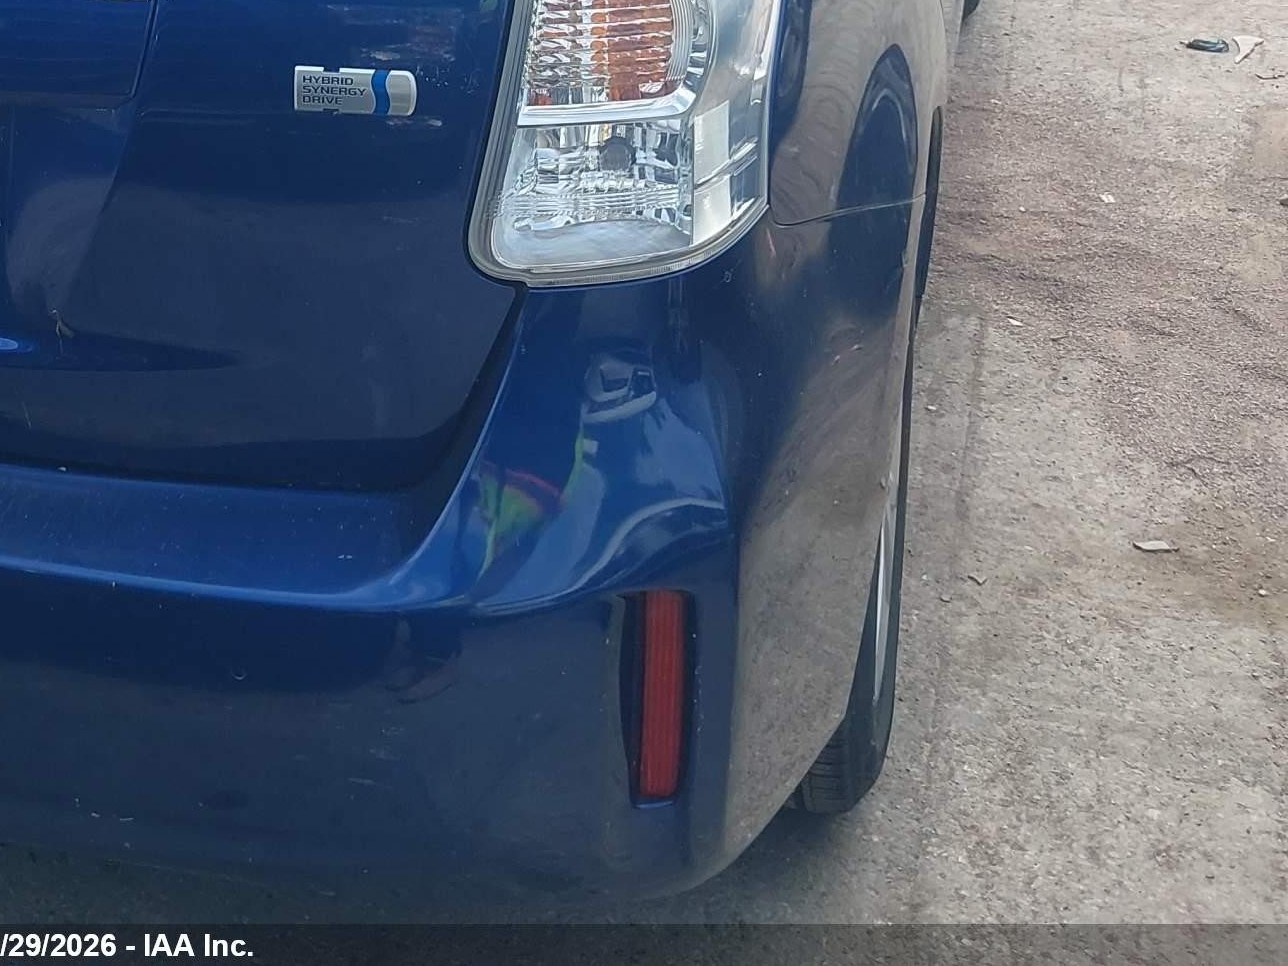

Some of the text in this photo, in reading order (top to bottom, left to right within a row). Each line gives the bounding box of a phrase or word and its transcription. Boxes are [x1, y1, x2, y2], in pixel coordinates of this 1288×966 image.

[302, 75, 354, 86] HYBRID
[302, 85, 367, 96] SYNERGY
[302, 95, 344, 105] DRIVE
